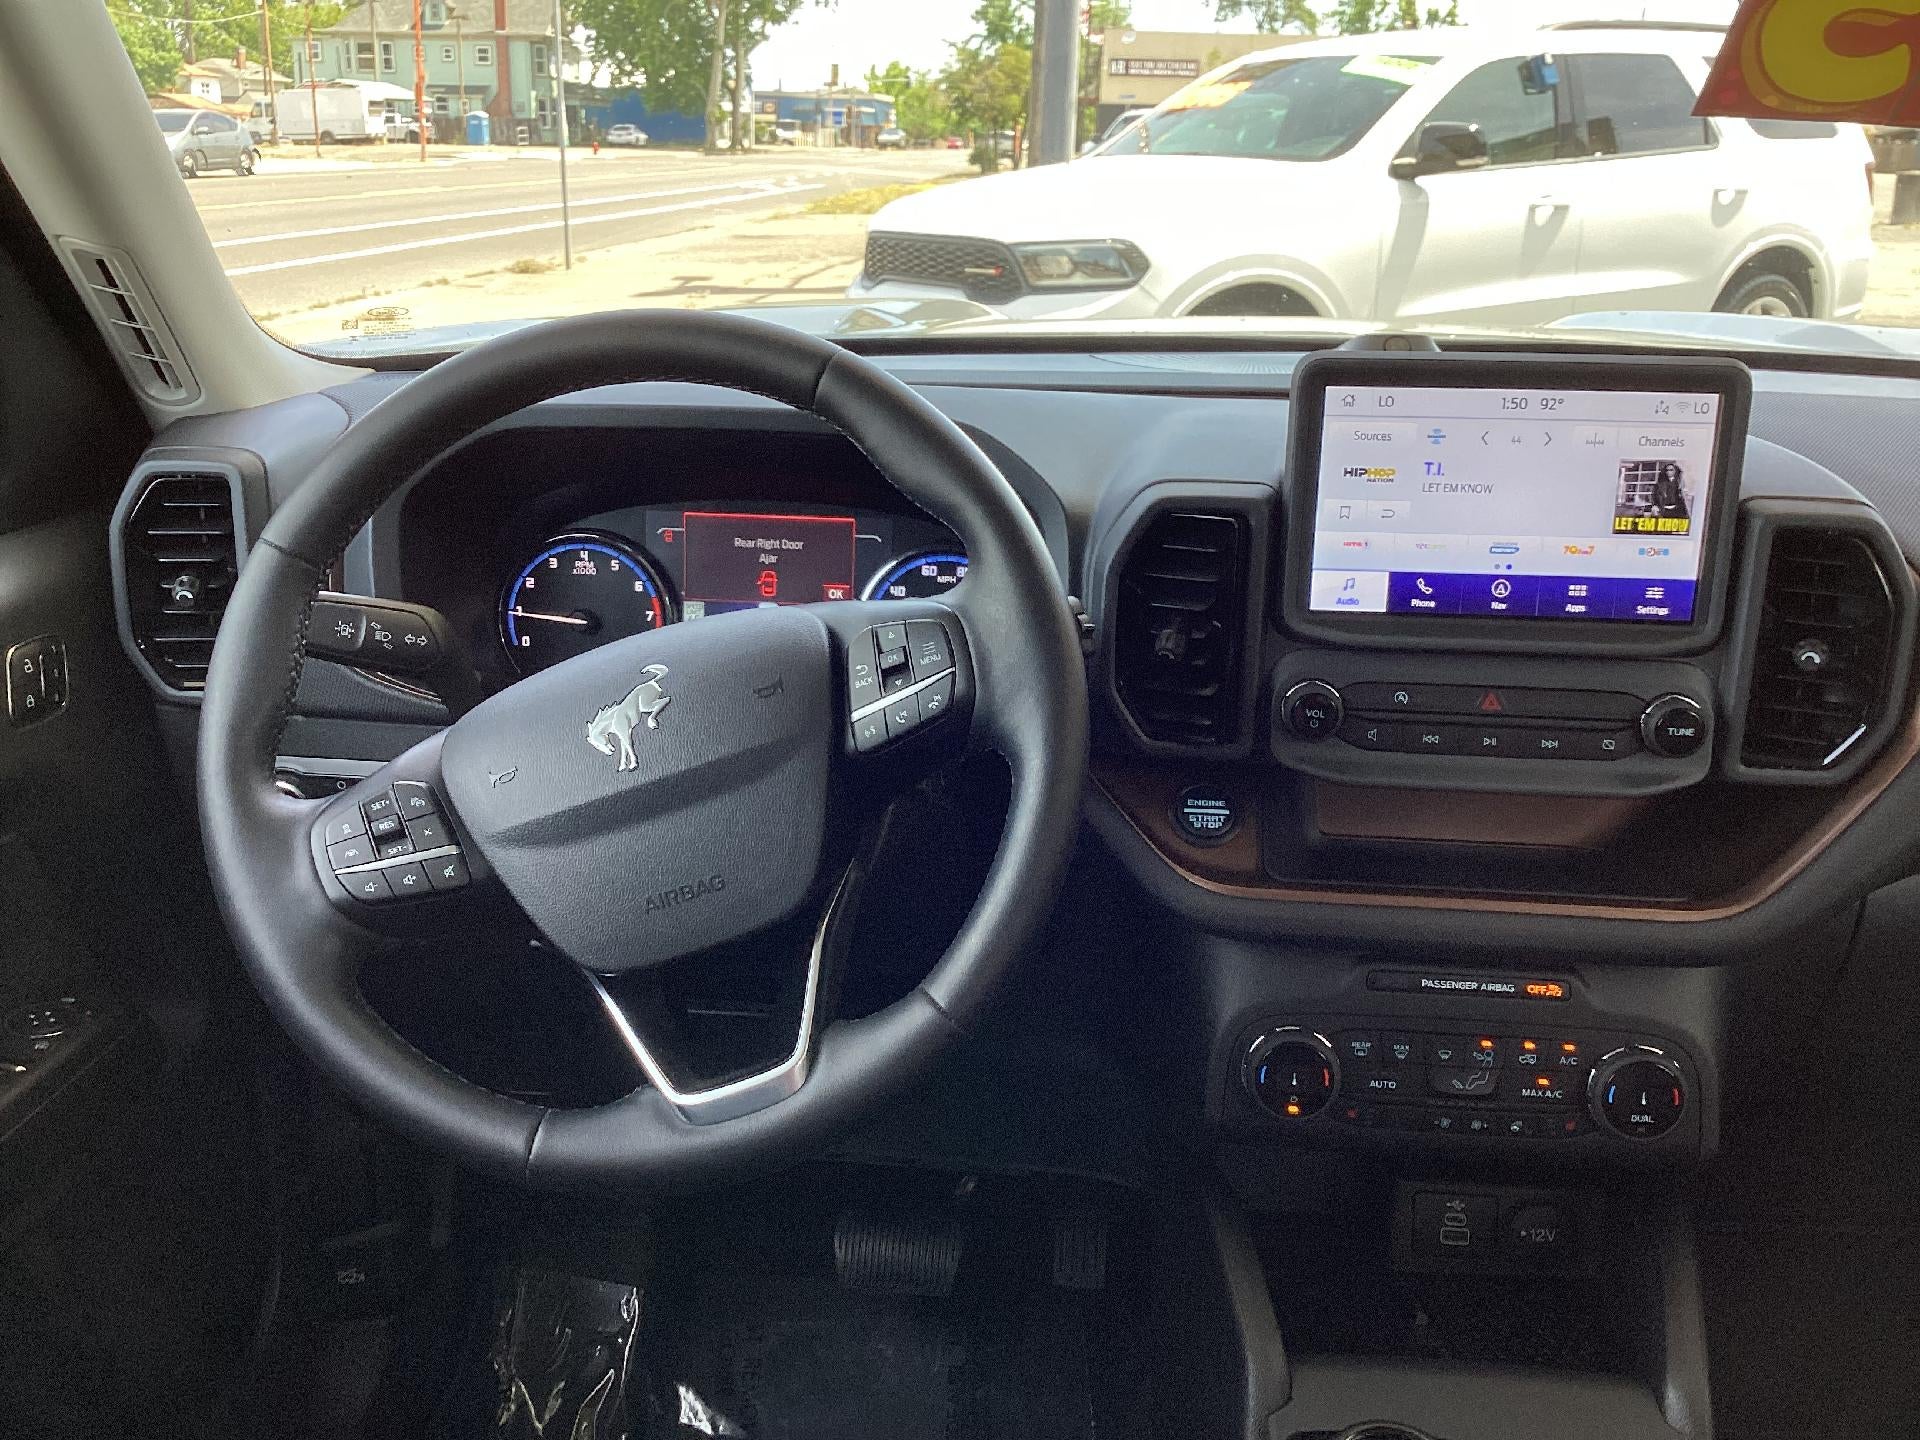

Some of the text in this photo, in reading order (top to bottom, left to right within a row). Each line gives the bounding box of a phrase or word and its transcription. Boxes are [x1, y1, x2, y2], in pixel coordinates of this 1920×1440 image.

[1378, 395, 1395, 408] LO
[1501, 397, 1528, 410] 1:50
[1694, 402, 1710, 414] LO
[1354, 430, 1392, 442] Sources
[1638, 436, 1685, 447] Channels
[1424, 461, 1445, 476] T.I.
[1422, 483, 1494, 494] LET EM KNOW
[1614, 517, 1632, 530] LET
[734, 537, 804, 550] Rear Right Door
[580, 551, 589, 561] 4
[758, 553, 779, 565] Ajar
[549, 558, 558, 568] 3
[611, 560, 620, 571] 5
[921, 565, 938, 576] 60
[525, 578, 535, 588] 2
[937, 575, 957, 583] MPH
[634, 581, 643, 592] 6
[889, 585, 906, 597] 40
[828, 589, 844, 599] OK
[1336, 597, 1360, 606] Audio
[1411, 599, 1436, 608] Phone
[1491, 602, 1508, 610] Nav
[1565, 603, 1586, 613] Apps
[1636, 606, 1669, 616] Settings
[646, 611, 654, 621] 7
[522, 636, 530, 646] 0
[920, 654, 941, 665] MENU
[855, 676, 873, 689] BACK
[1306, 708, 1326, 718] VOL
[1667, 727, 1696, 737] TUNE
[1187, 799, 1226, 807] ENGINE
[1188, 814, 1226, 823] START
[378, 821, 395, 830] RES
[1193, 821, 1223, 829] STOP
[645, 874, 726, 915] AIRBAG
[1421, 978, 1478, 990] PASSENGER
[1480, 981, 1515, 993] AIRBAG
[1559, 1056, 1578, 1066] A/C
[1369, 1079, 1397, 1089] AUTO
[1521, 1088, 1563, 1100] MAX A/C
[1630, 1114, 1655, 1123] DUAL
